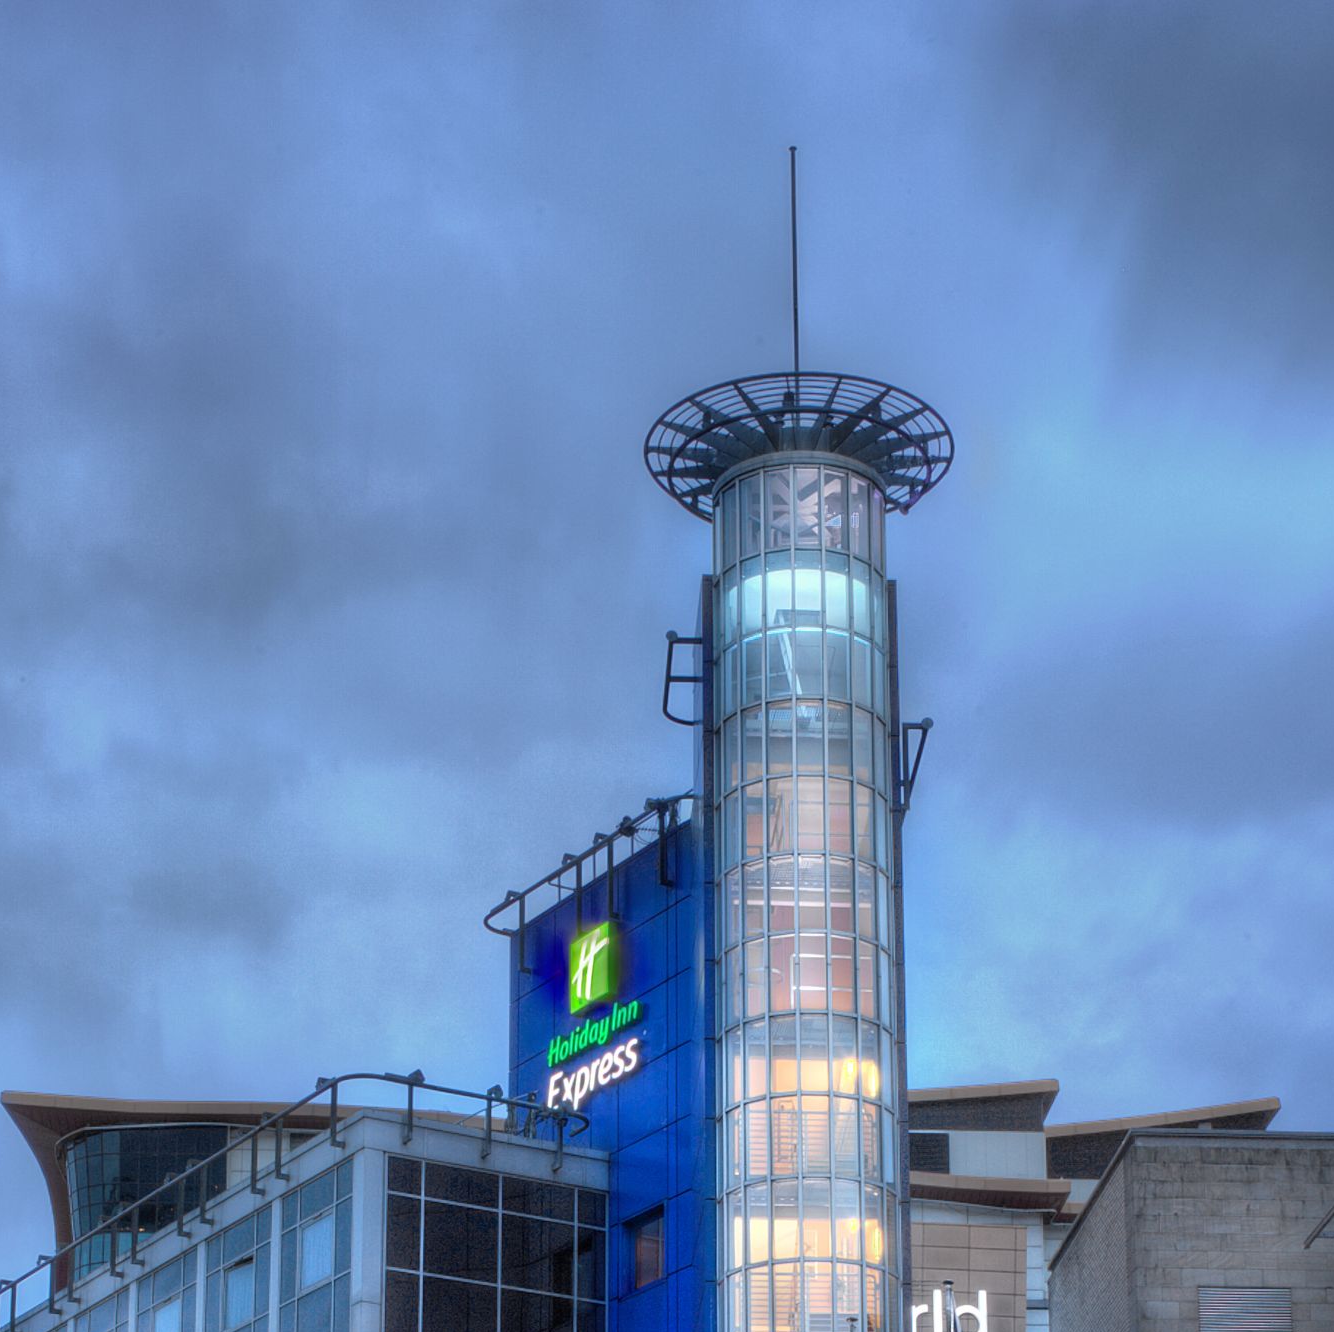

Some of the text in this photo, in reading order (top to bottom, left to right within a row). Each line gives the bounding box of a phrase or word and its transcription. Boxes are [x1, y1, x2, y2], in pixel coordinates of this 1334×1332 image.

[548, 1000, 639, 1068] Holiday Inn
[547, 1037, 638, 1111] Express
